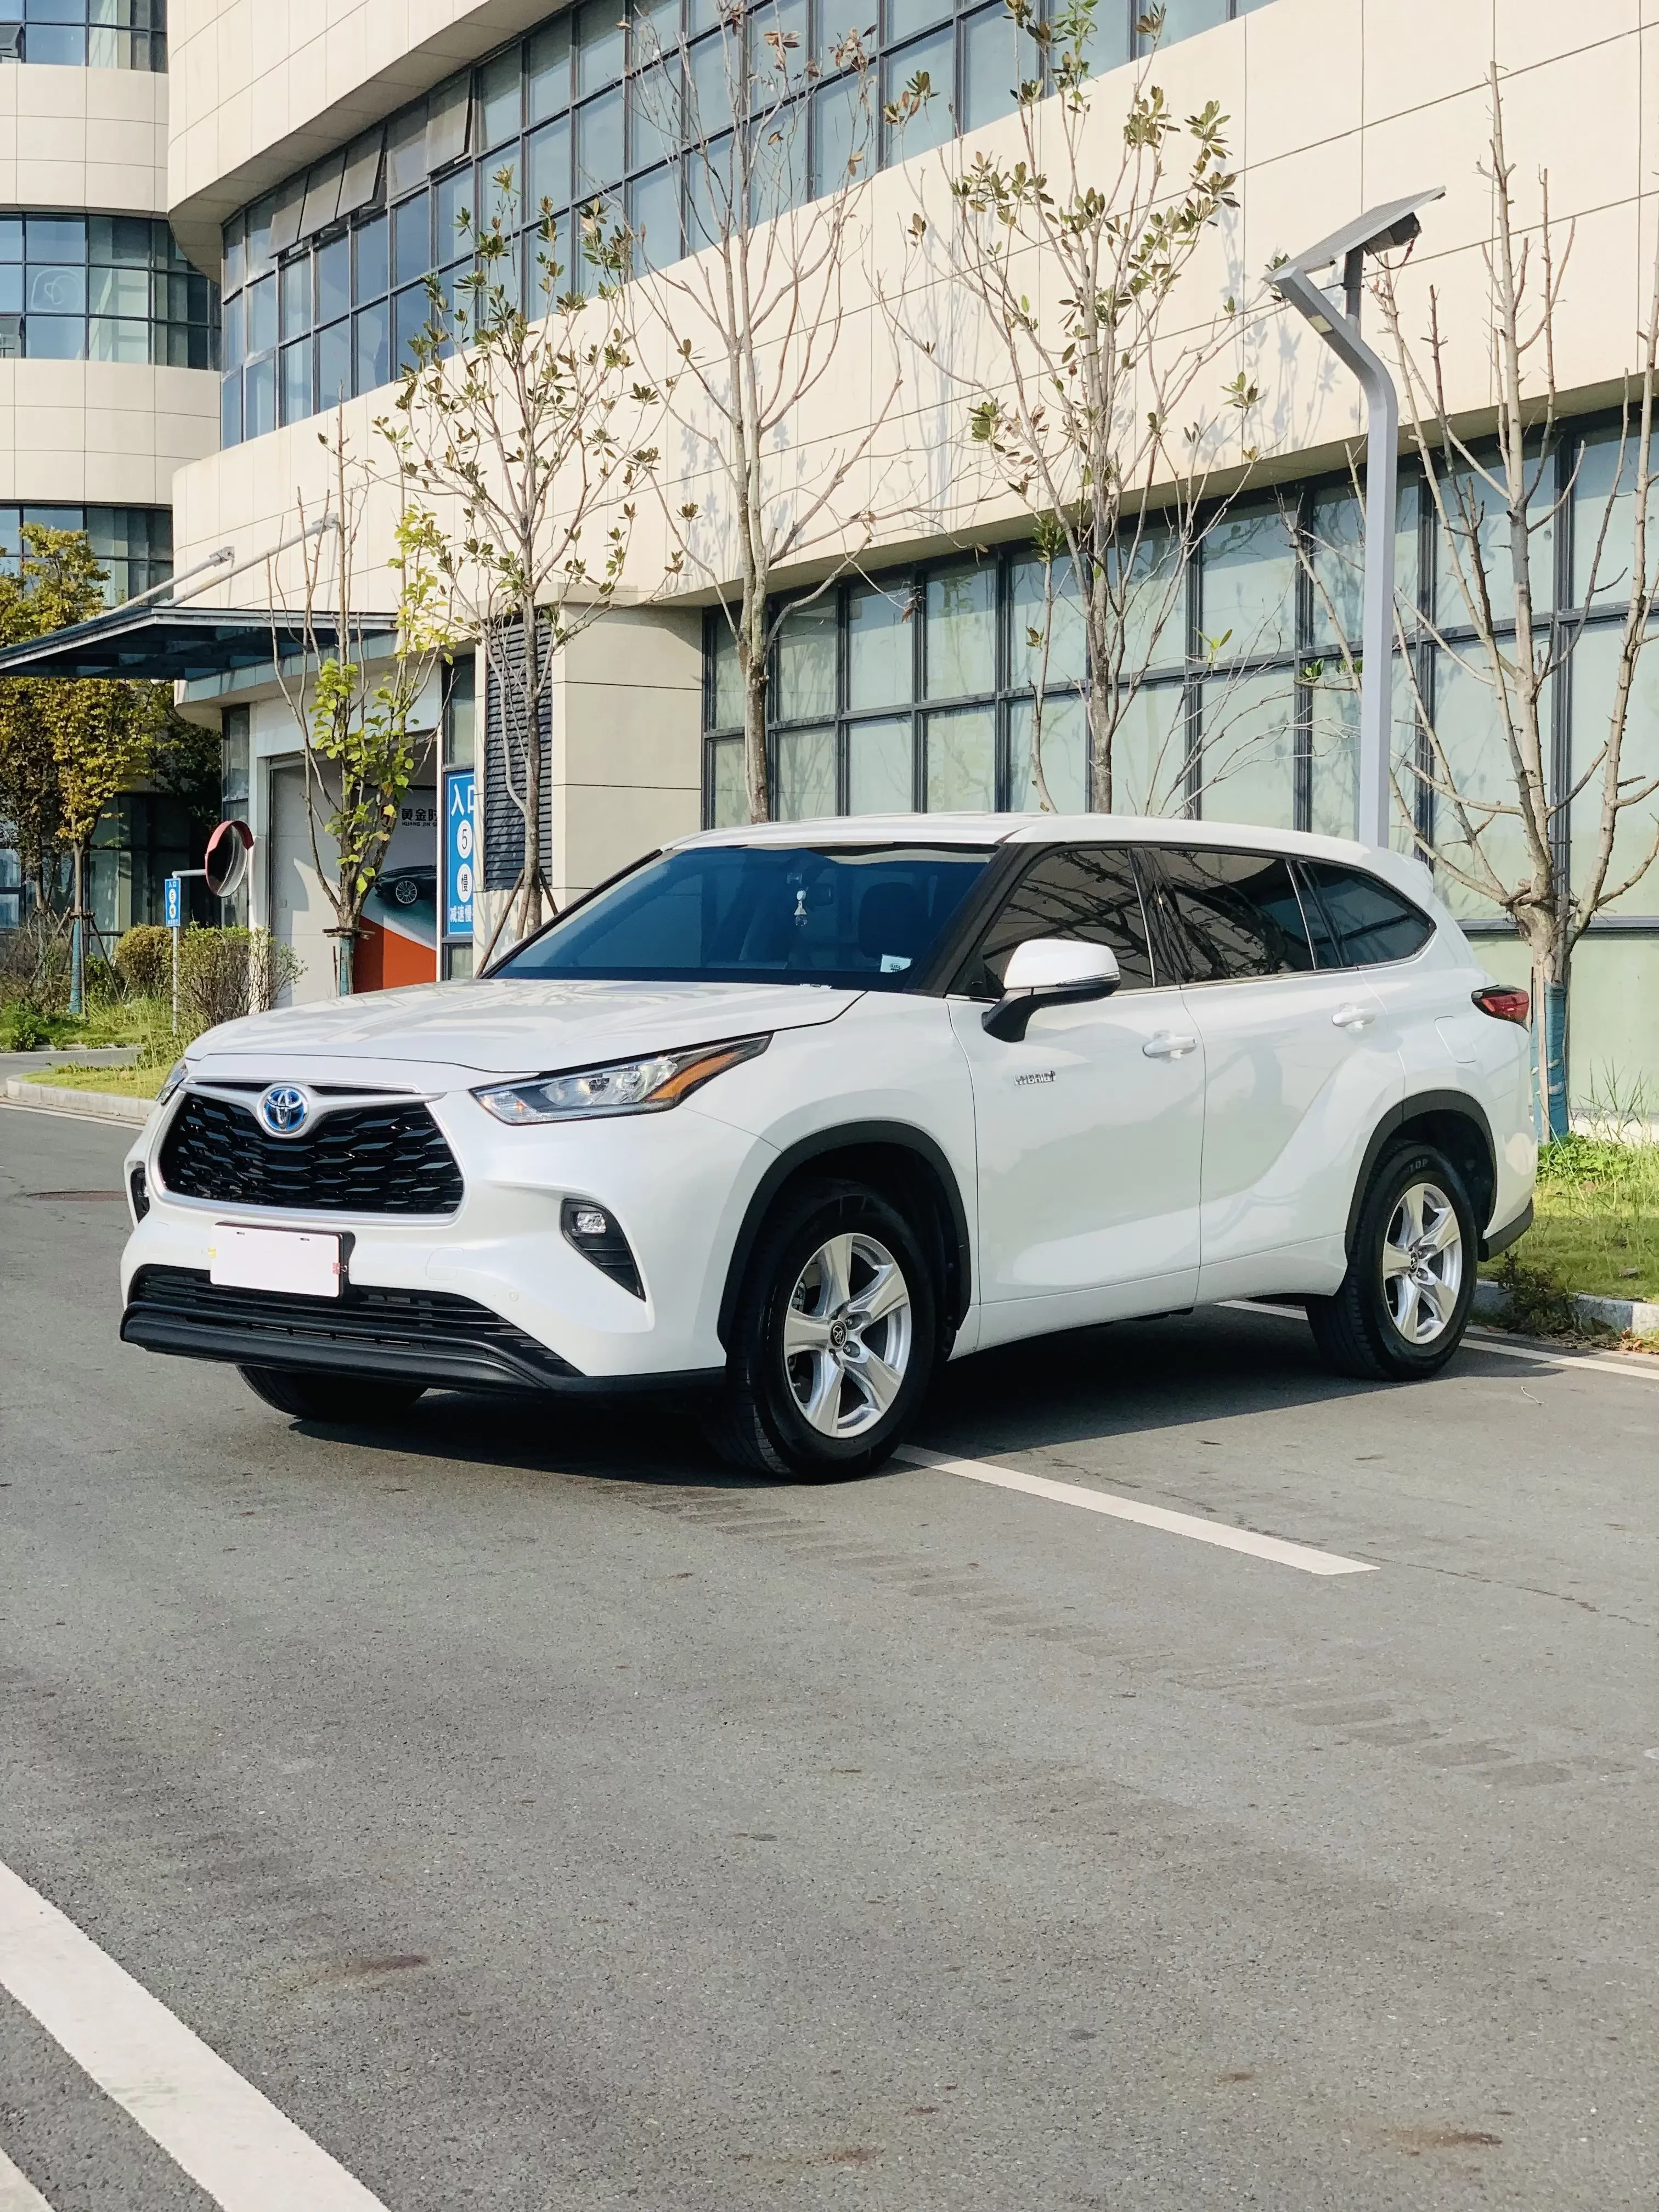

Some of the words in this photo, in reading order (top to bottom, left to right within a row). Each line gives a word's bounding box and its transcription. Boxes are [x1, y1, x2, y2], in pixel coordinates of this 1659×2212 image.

[462, 829, 467, 850] 5
[450, 905, 473, 923] 减速慢
